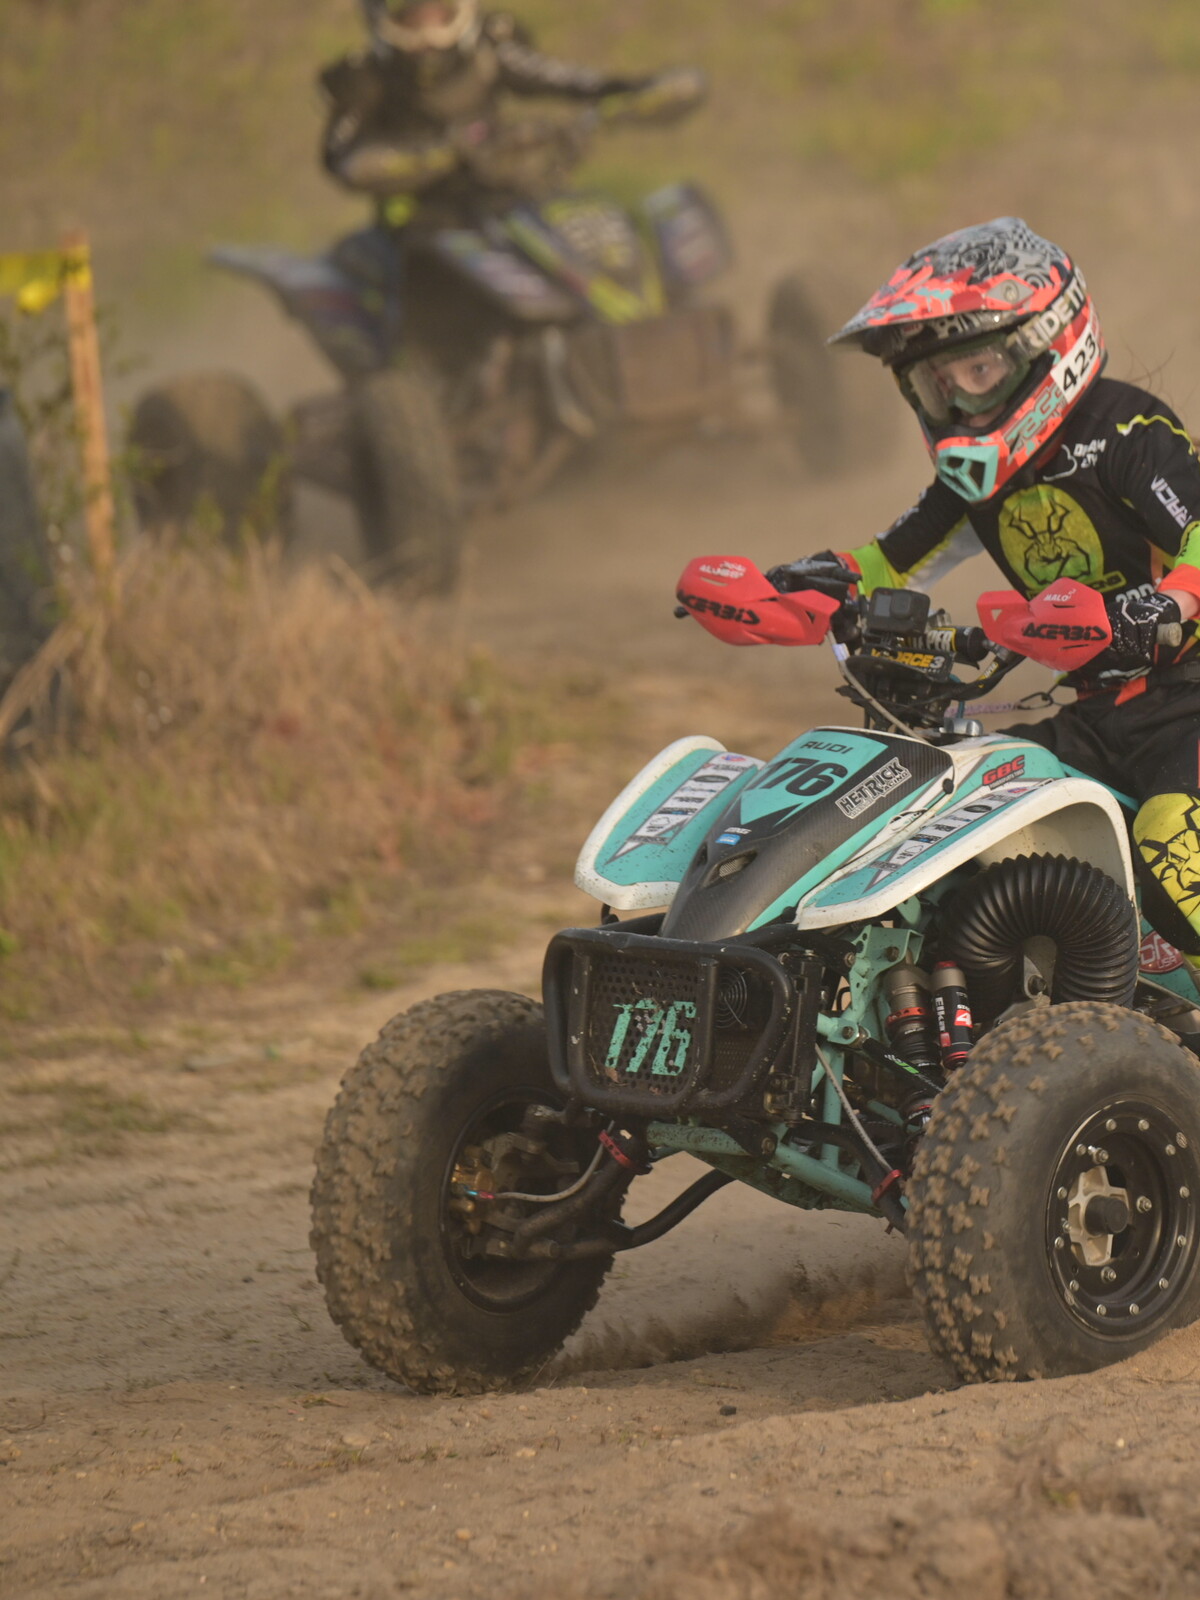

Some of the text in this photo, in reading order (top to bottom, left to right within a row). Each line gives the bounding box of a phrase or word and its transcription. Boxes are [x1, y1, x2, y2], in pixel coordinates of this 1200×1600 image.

[1063, 334, 1096, 392] 423
[1151, 474, 1192, 529] RACIN
[1022, 622, 1108, 641] ACERBIS
[745, 757, 848, 797] 176
[840, 762, 905, 814] HETRICK
[982, 754, 1025, 785] GBC
[604, 998, 697, 1076] 176
[956, 1012, 972, 1026] 4
